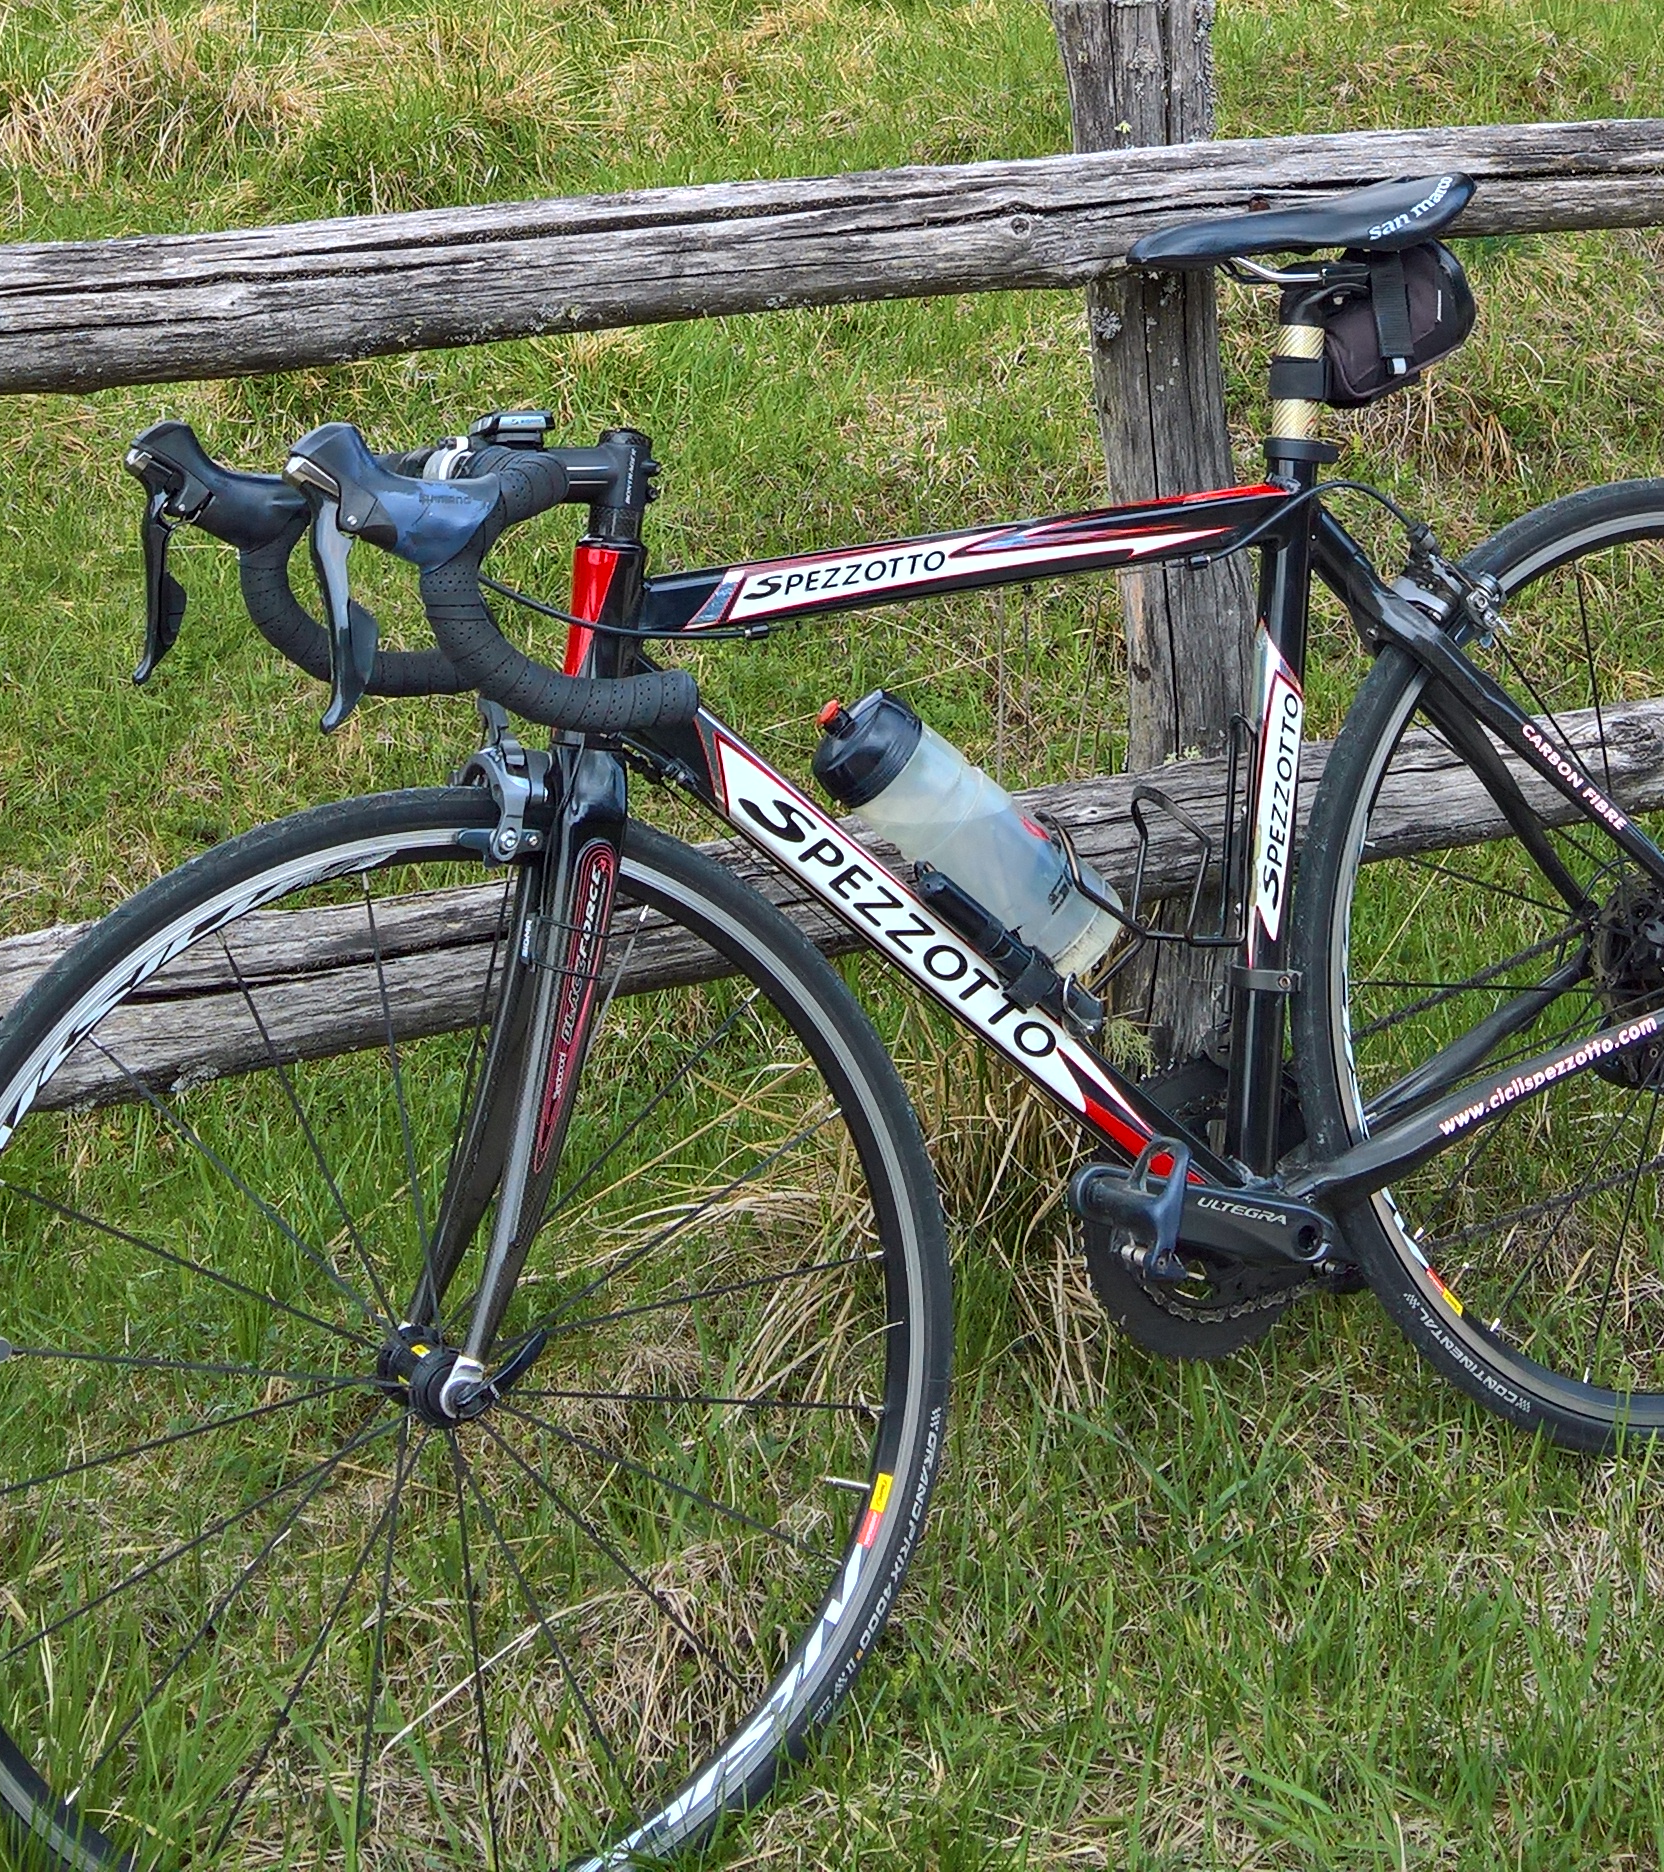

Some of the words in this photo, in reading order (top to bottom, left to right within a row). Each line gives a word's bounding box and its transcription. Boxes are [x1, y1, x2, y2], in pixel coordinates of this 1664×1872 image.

[1368, 213, 1411, 241] san
[743, 550, 946, 600] SPEZZOTTO
[1263, 693, 1299, 910] SPEZZOTTO
[1522, 724, 1584, 789] CARBON
[1582, 787, 1628, 831] FIBRE
[738, 798, 1057, 1058] SPEZZOTTO
[1438, 1016, 1658, 1136] www.ciclispezzotto.com
[1196, 1196, 1287, 1225] ULTEGRA
[1420, 1307, 1519, 1404] CONTINENTAL
